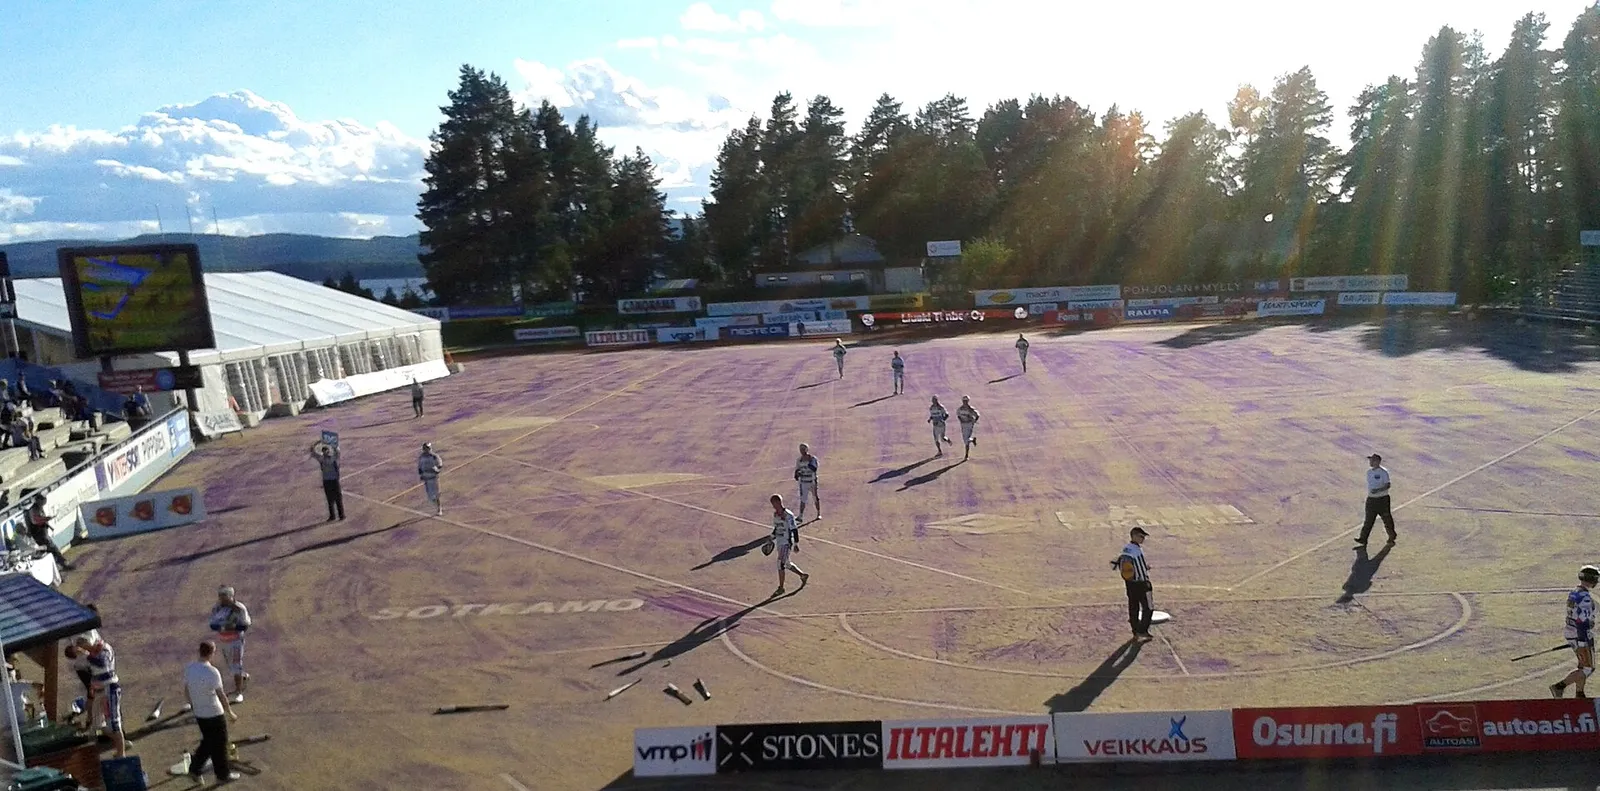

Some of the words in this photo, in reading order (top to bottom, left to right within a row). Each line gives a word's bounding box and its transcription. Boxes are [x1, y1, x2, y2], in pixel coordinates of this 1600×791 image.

[970, 309, 986, 321] Oy
[1127, 308, 1170, 317] RAUTIA
[369, 598, 645, 620] SOTKAMO
[1252, 712, 1398, 753] Osuma.fi
[1482, 713, 1596, 737] autoasi.fi
[762, 733, 879, 760] STONES
[887, 723, 1049, 761] ILTALEHTI
[1083, 737, 1208, 755] VEIKKAUS
[1429, 737, 1477, 747] AUTOASI
[637, 744, 688, 763] vmp
